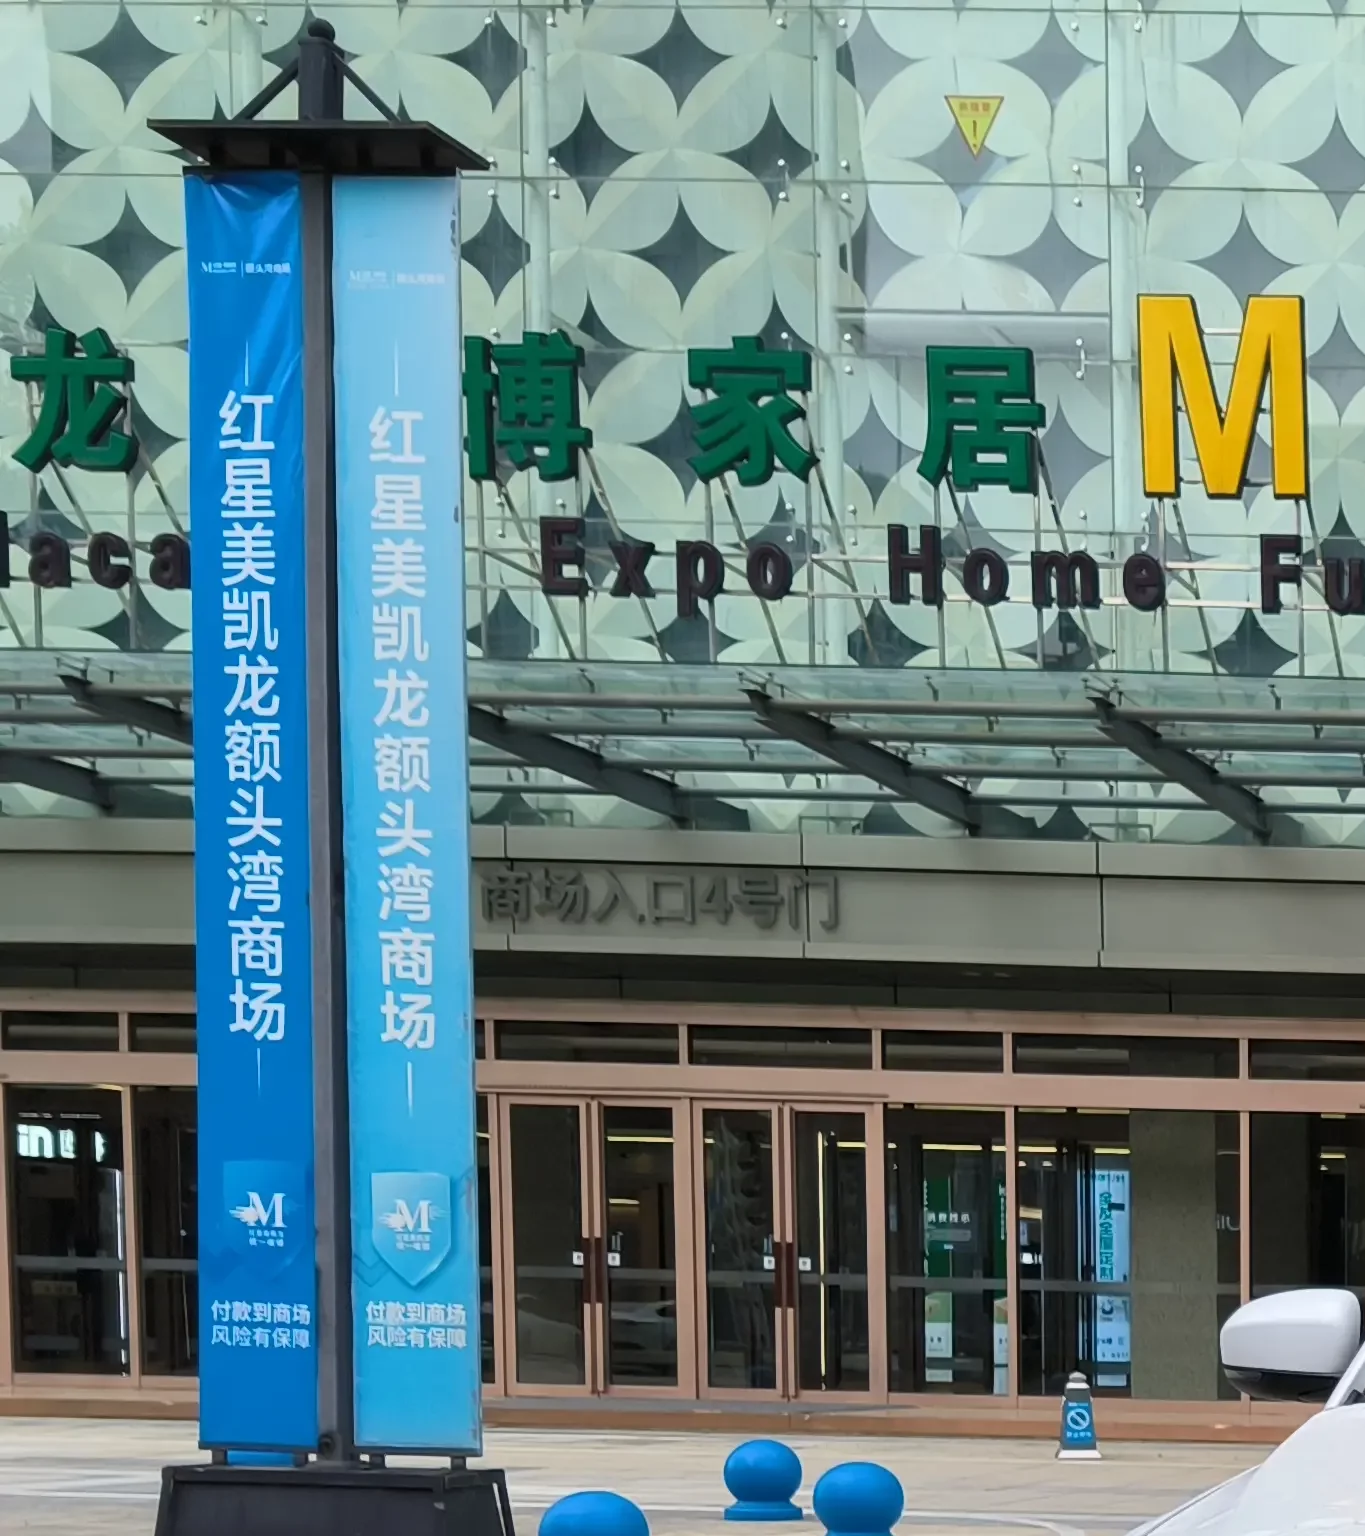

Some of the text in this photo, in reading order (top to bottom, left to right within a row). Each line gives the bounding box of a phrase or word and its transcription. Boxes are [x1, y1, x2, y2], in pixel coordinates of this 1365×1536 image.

[10, 327, 1046, 497] 龙 博家居
[539, 516, 794, 619] Expo
[887, 523, 1167, 613] Home
[219, 390, 285, 1041] 红星美凯龙额头湾商场
[369, 405, 435, 1050] 红星美凯龙额头湾商场
[481, 868, 840, 933] 商场入口4号门
[210, 1300, 311, 1326] 付款到商场
[210, 1325, 311, 1349] 风险有保障
[365, 1300, 467, 1326] 付款到商场
[366, 1325, 467, 1349] 风险有保障
